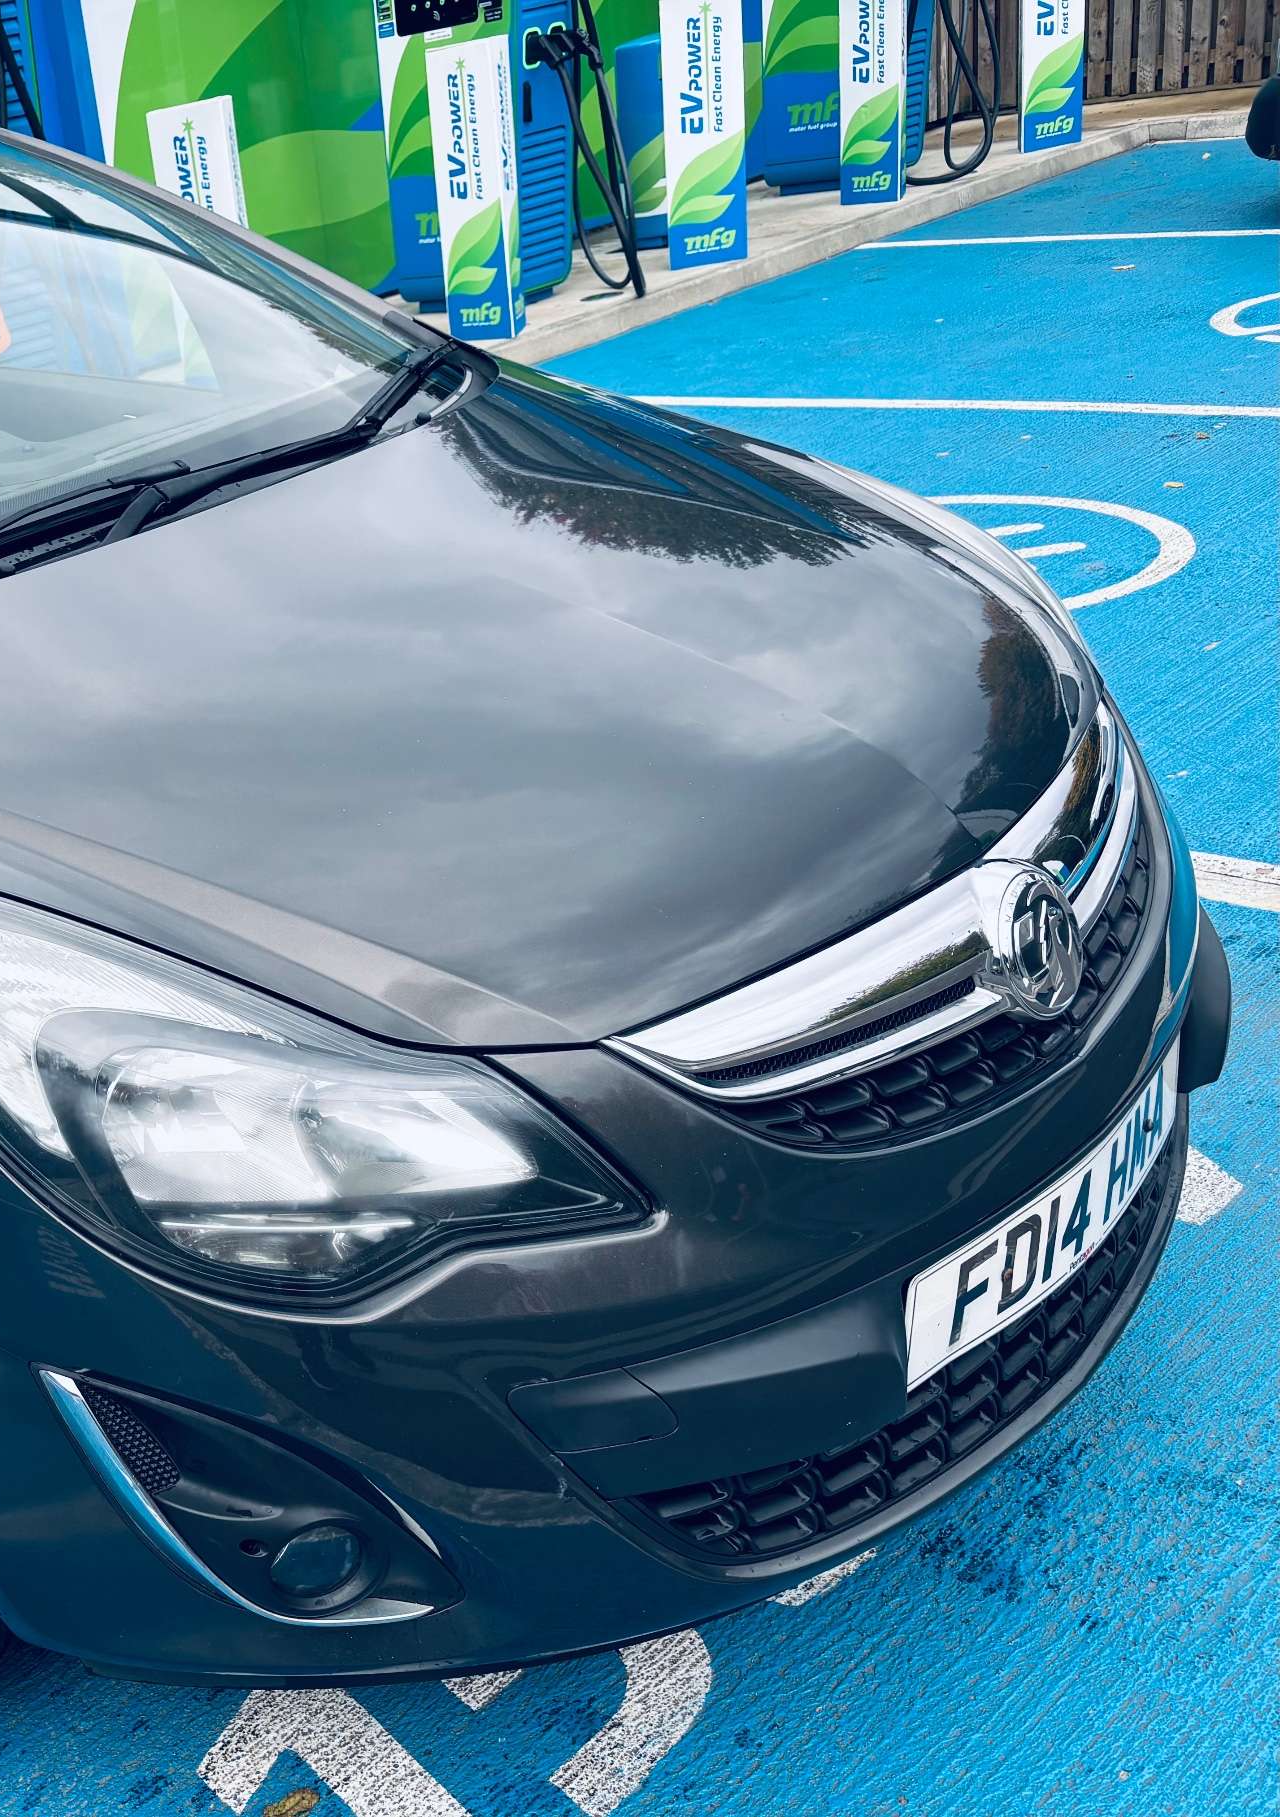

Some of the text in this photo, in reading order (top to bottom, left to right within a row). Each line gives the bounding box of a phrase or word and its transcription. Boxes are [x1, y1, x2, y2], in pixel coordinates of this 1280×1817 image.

[877, 23, 885, 56] Clean
[711, 16, 722, 132] Fast Clean Energy
[877, 60, 885, 83] Fast
[787, 91, 839, 126] mf
[1035, 115, 1075, 135] mfg
[467, 74, 484, 200] Fast Clean Energy
[197, 136, 212, 190] Energy
[852, 170, 892, 191] mfg
[684, 227, 736, 251] mfg
[460, 301, 501, 325] mfg
[948, 1168, 1093, 1348] FD14
